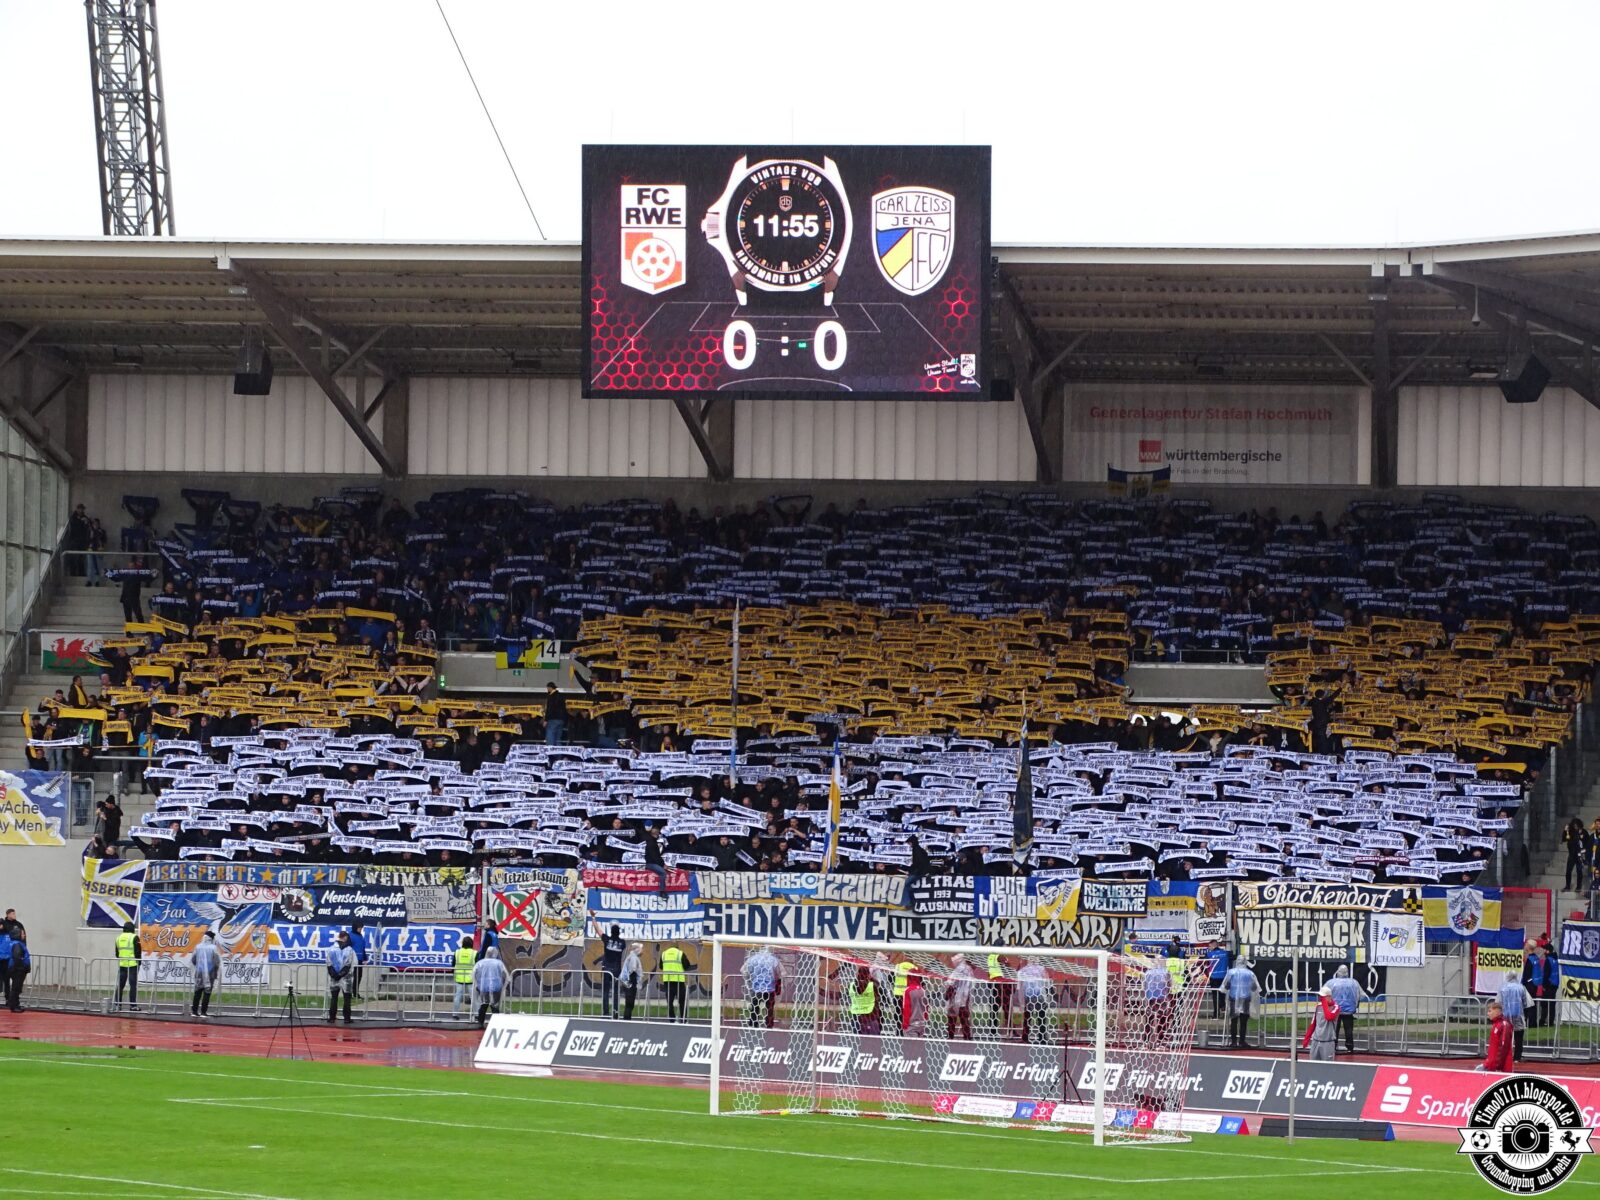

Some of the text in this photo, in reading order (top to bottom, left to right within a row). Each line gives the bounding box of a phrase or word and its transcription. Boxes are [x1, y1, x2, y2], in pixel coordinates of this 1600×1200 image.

[750, 165, 798, 185] VINTAGE
[637, 187, 670, 206] FC
[879, 194, 948, 213] CARL ZEISS
[625, 207, 682, 225] RWE
[753, 214, 819, 237] 11:55
[890, 216, 936, 227] JENA
[735, 249, 837, 284] HANDMADE IN ERFURT
[722, 319, 757, 371] 0
[813, 319, 848, 371] 0
[1089, 406, 1333, 422] Generalagentur Stefan Hochmuth
[1165, 449, 1282, 464] württembergische
[14, 818, 43, 832] Men
[278, 868, 311, 885] MIT
[364, 871, 442, 886] WEIMAR
[582, 869, 689, 887] SCHICKEIA
[321, 889, 406, 905] Menschenrechte
[412, 889, 437, 897] SPIEL
[1083, 882, 1146, 898] REFUGEES
[1263, 882, 1398, 913] Rockendorf
[317, 908, 332, 916] aus
[334, 905, 351, 916] dem
[413, 902, 437, 910] DEIN
[600, 892, 689, 911] UNBEUGSAM
[914, 900, 975, 913] LAUSANNE
[1083, 897, 1145, 912] WELCOME
[155, 899, 188, 924] Fan
[703, 903, 887, 941] SÜDKURVE
[891, 917, 977, 940] ULTRAS
[155, 926, 190, 949] Club
[277, 925, 461, 952] WEMAR
[1237, 917, 1366, 947] WOLFPACK
[1253, 945, 1275, 957] FCC
[1376, 954, 1420, 964] CHAOTEN
[1477, 952, 1523, 969] EISENBERG
[569, 1035, 668, 1057] SWE Für Erfurt.
[688, 1042, 793, 1065] SW Für Erfurt.
[816, 1049, 923, 1074] SWE Für Erfurt.
[945, 1058, 1060, 1083] SWE Für Erfurt.
[1127, 1069, 1156, 1088] Für
[1155, 1071, 1204, 1092] Erfurt.
[1229, 1075, 1266, 1095] SWE
[1304, 1080, 1357, 1102] Erfurt.
[1416, 1095, 1472, 1120] Spark
[1582, 1105, 1600, 1129] Sp
